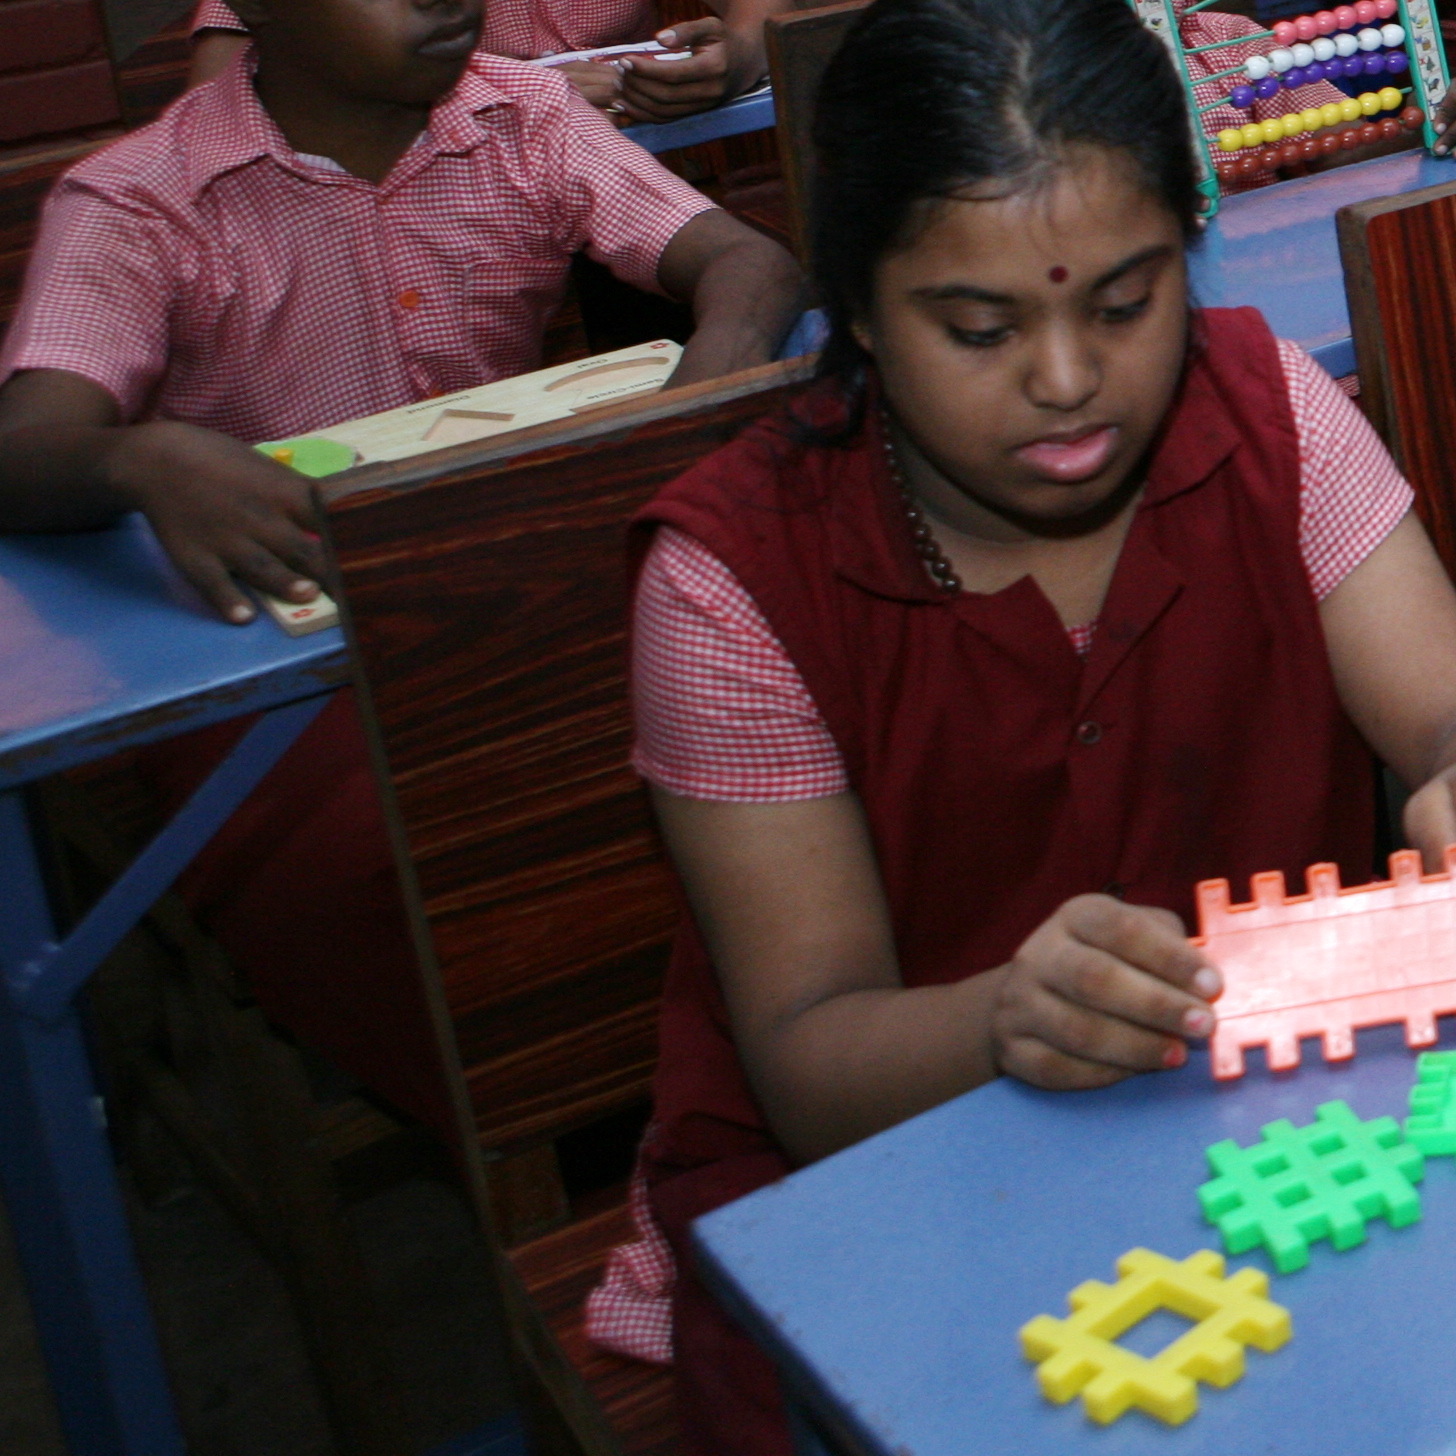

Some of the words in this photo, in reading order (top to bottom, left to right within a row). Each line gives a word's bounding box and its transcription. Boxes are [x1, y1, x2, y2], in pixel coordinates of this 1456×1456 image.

[577, 359, 608, 369] Oval
[586, 378, 664, 399] Semi-Circle
[407, 395, 471, 414] Diamond
